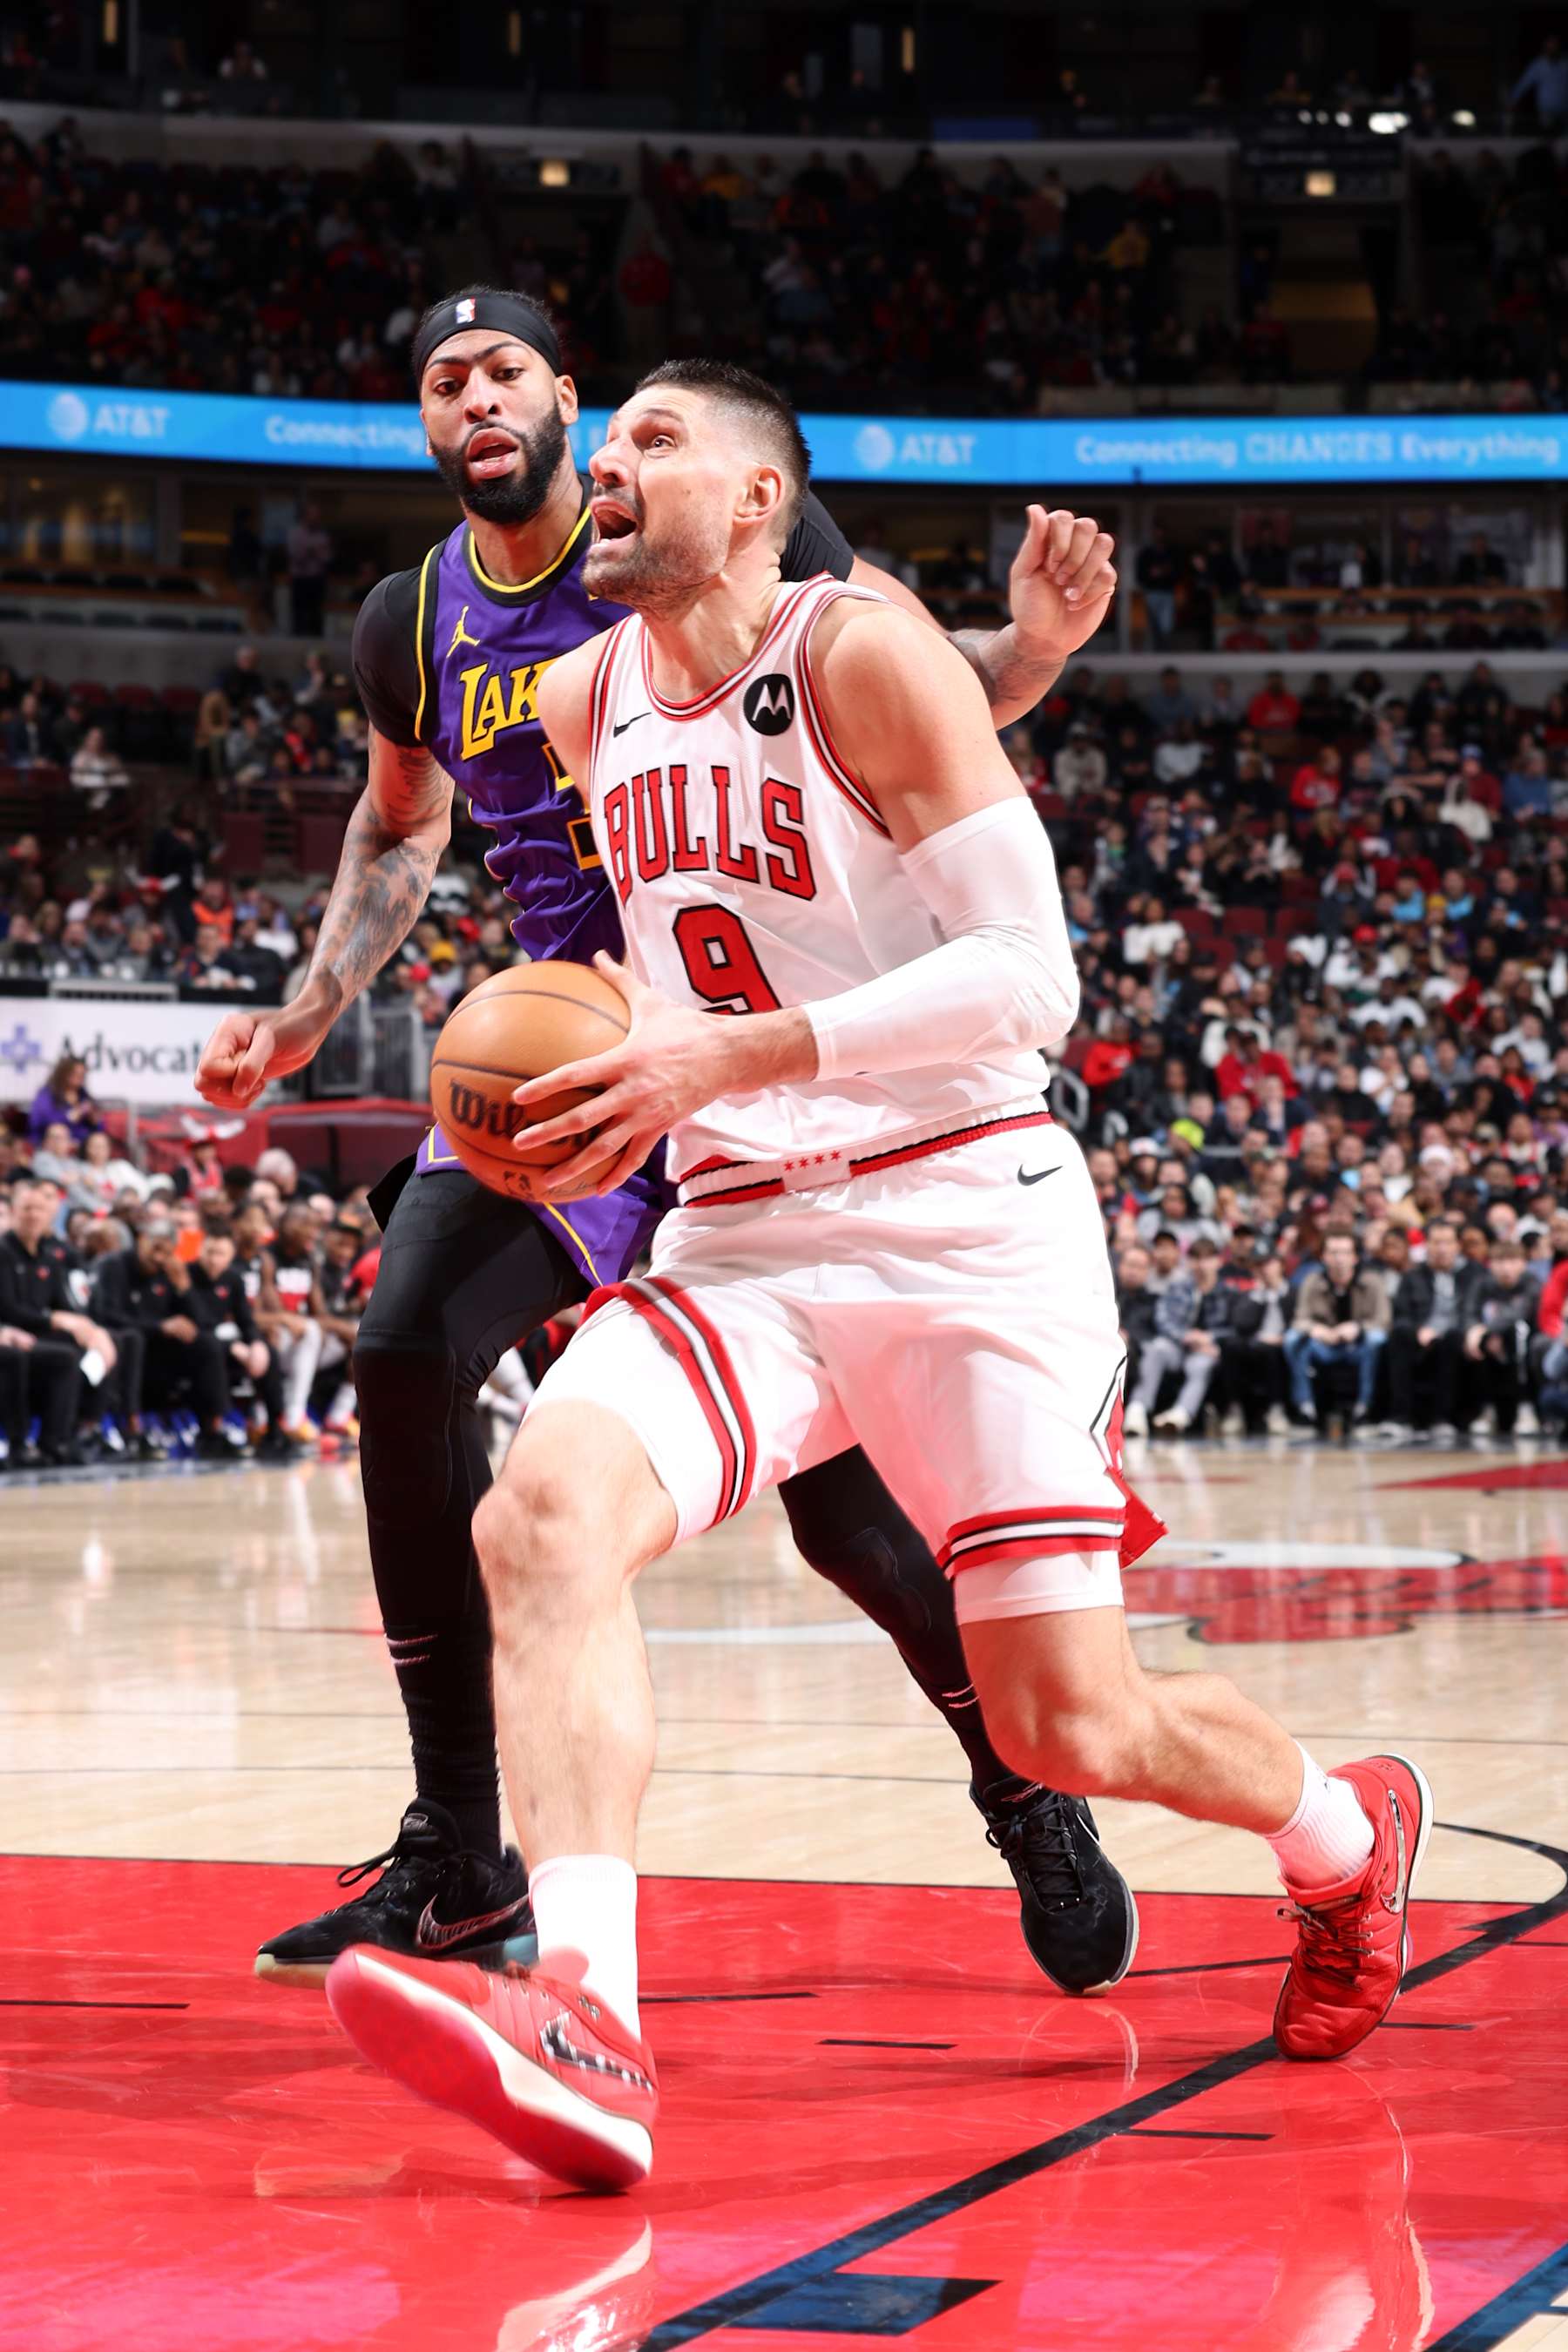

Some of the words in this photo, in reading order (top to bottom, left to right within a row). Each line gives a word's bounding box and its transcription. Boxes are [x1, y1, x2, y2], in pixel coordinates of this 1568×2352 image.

[93, 404, 169, 439] AT&T
[900, 435, 977, 465] AT&T
[1075, 434, 1238, 468] Connecting
[1401, 432, 1560, 467] Everything
[460, 655, 563, 762] LAK
[604, 764, 817, 912] BULLS
[672, 902, 783, 1016] 9
